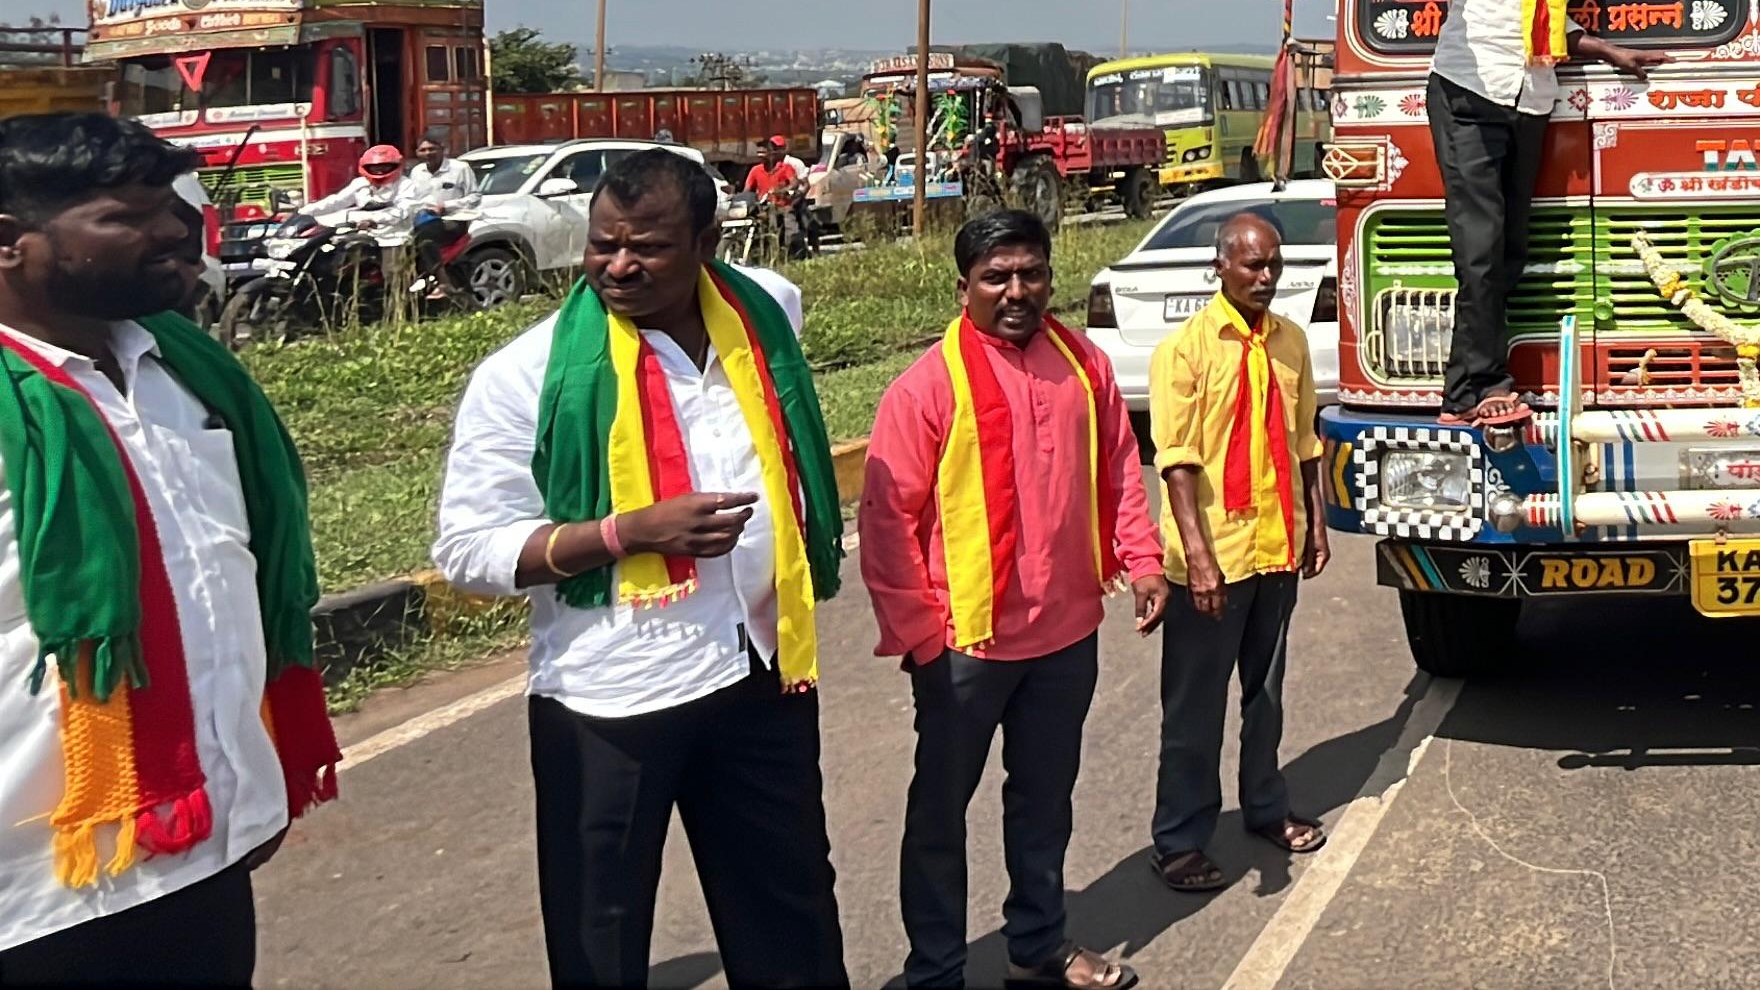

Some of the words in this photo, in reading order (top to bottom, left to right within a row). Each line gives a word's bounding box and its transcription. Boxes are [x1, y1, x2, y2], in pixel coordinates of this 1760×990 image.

[1411, 1, 1443, 38] श्री
[1607, 1, 1684, 33] प्रसन्न
[1647, 89, 1728, 111] राजा
[1680, 175, 1704, 192] श्री
[1539, 557, 1657, 589] ROAD
